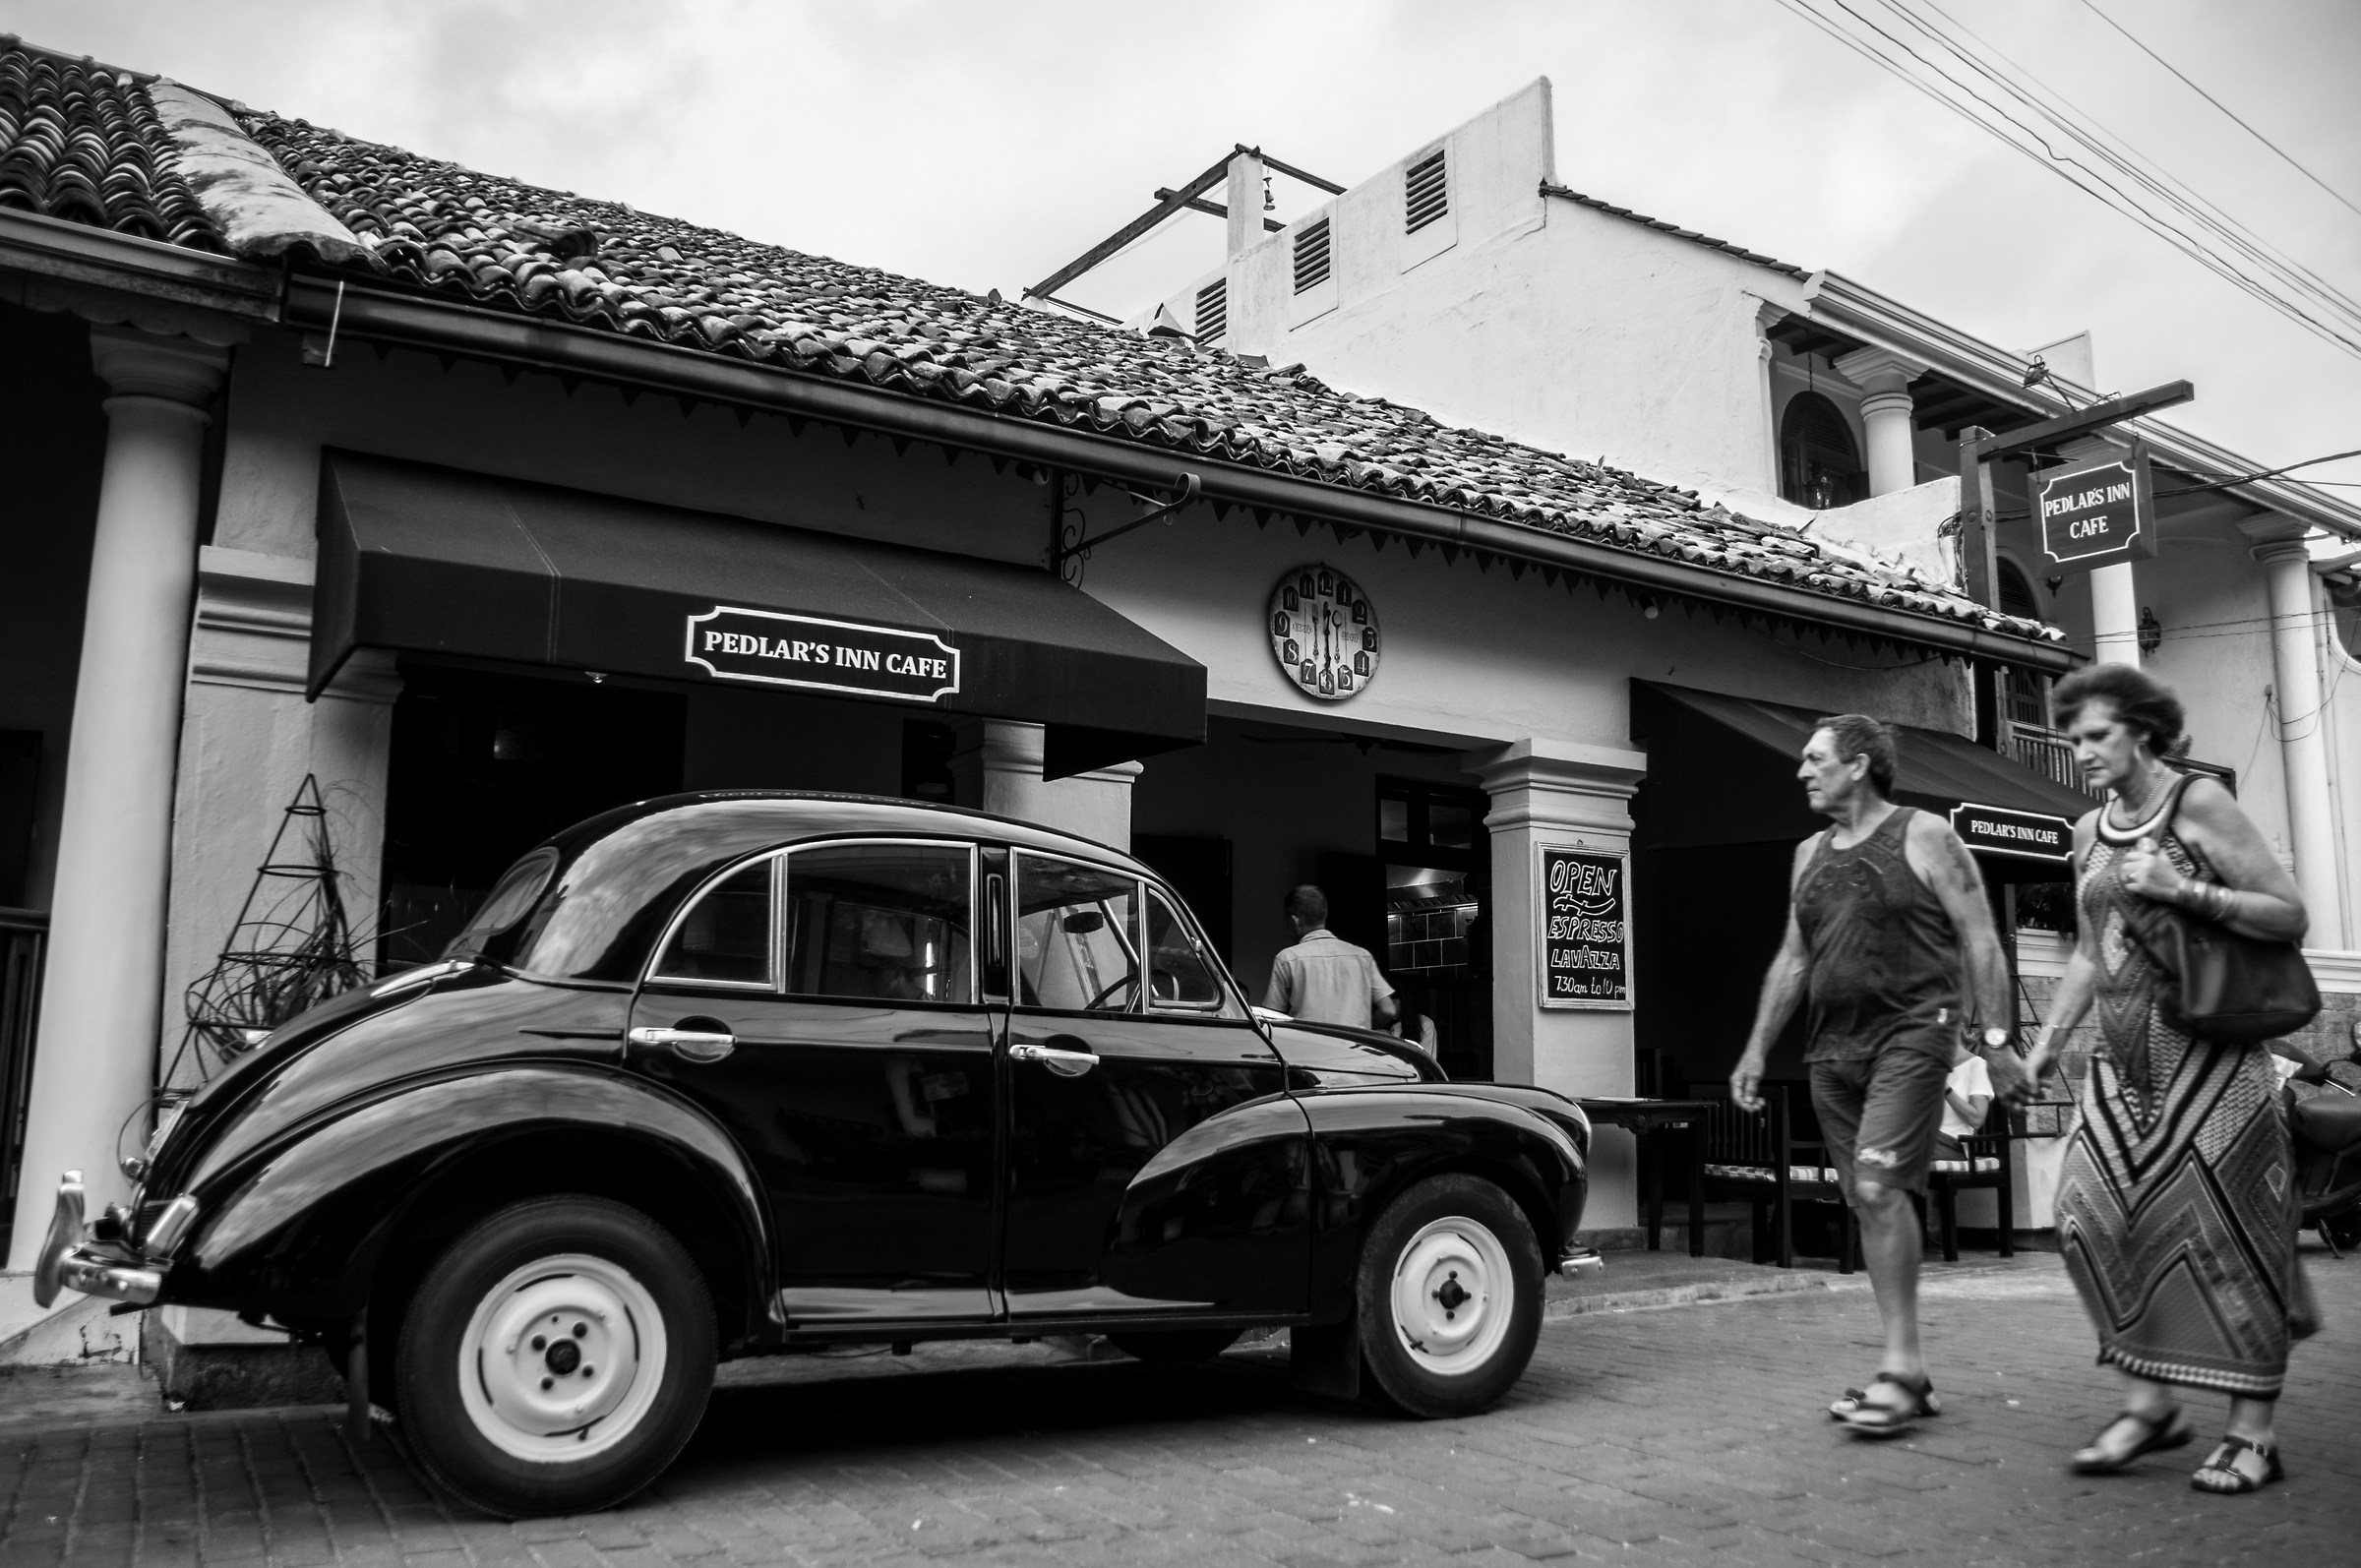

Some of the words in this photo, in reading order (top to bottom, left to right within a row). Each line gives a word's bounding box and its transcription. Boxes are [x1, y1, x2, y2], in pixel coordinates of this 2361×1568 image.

[2045, 488, 2104, 517] PEDLAR'S
[2106, 482, 2130, 503] INN
[2070, 515, 2109, 538] CAFE
[1303, 580, 1313, 596] 11
[1320, 577, 1332, 593] 12
[1287, 590, 1298, 609] 10
[1356, 604, 1364, 621] 2
[1279, 615, 1288, 633] 9
[1366, 631, 1375, 648] 3
[1287, 642, 1298, 662] 8
[835, 646, 880, 671] INN
[886, 653, 946, 679] CAFE
[1303, 662, 1314, 681] 7
[1357, 655, 1366, 673] 4
[1320, 671, 1332, 692] 6
[1342, 669, 1351, 688] 5
[1970, 819, 2016, 838] PEDLAR'S
[2017, 826, 2034, 841] INN
[2035, 829, 2058, 844] CAFE
[1549, 860, 1618, 896] OPEN
[1547, 916, 1624, 943] ESPRESSO
[1550, 944, 1620, 970] LAVAZZA
[1614, 985, 1626, 999] pm
